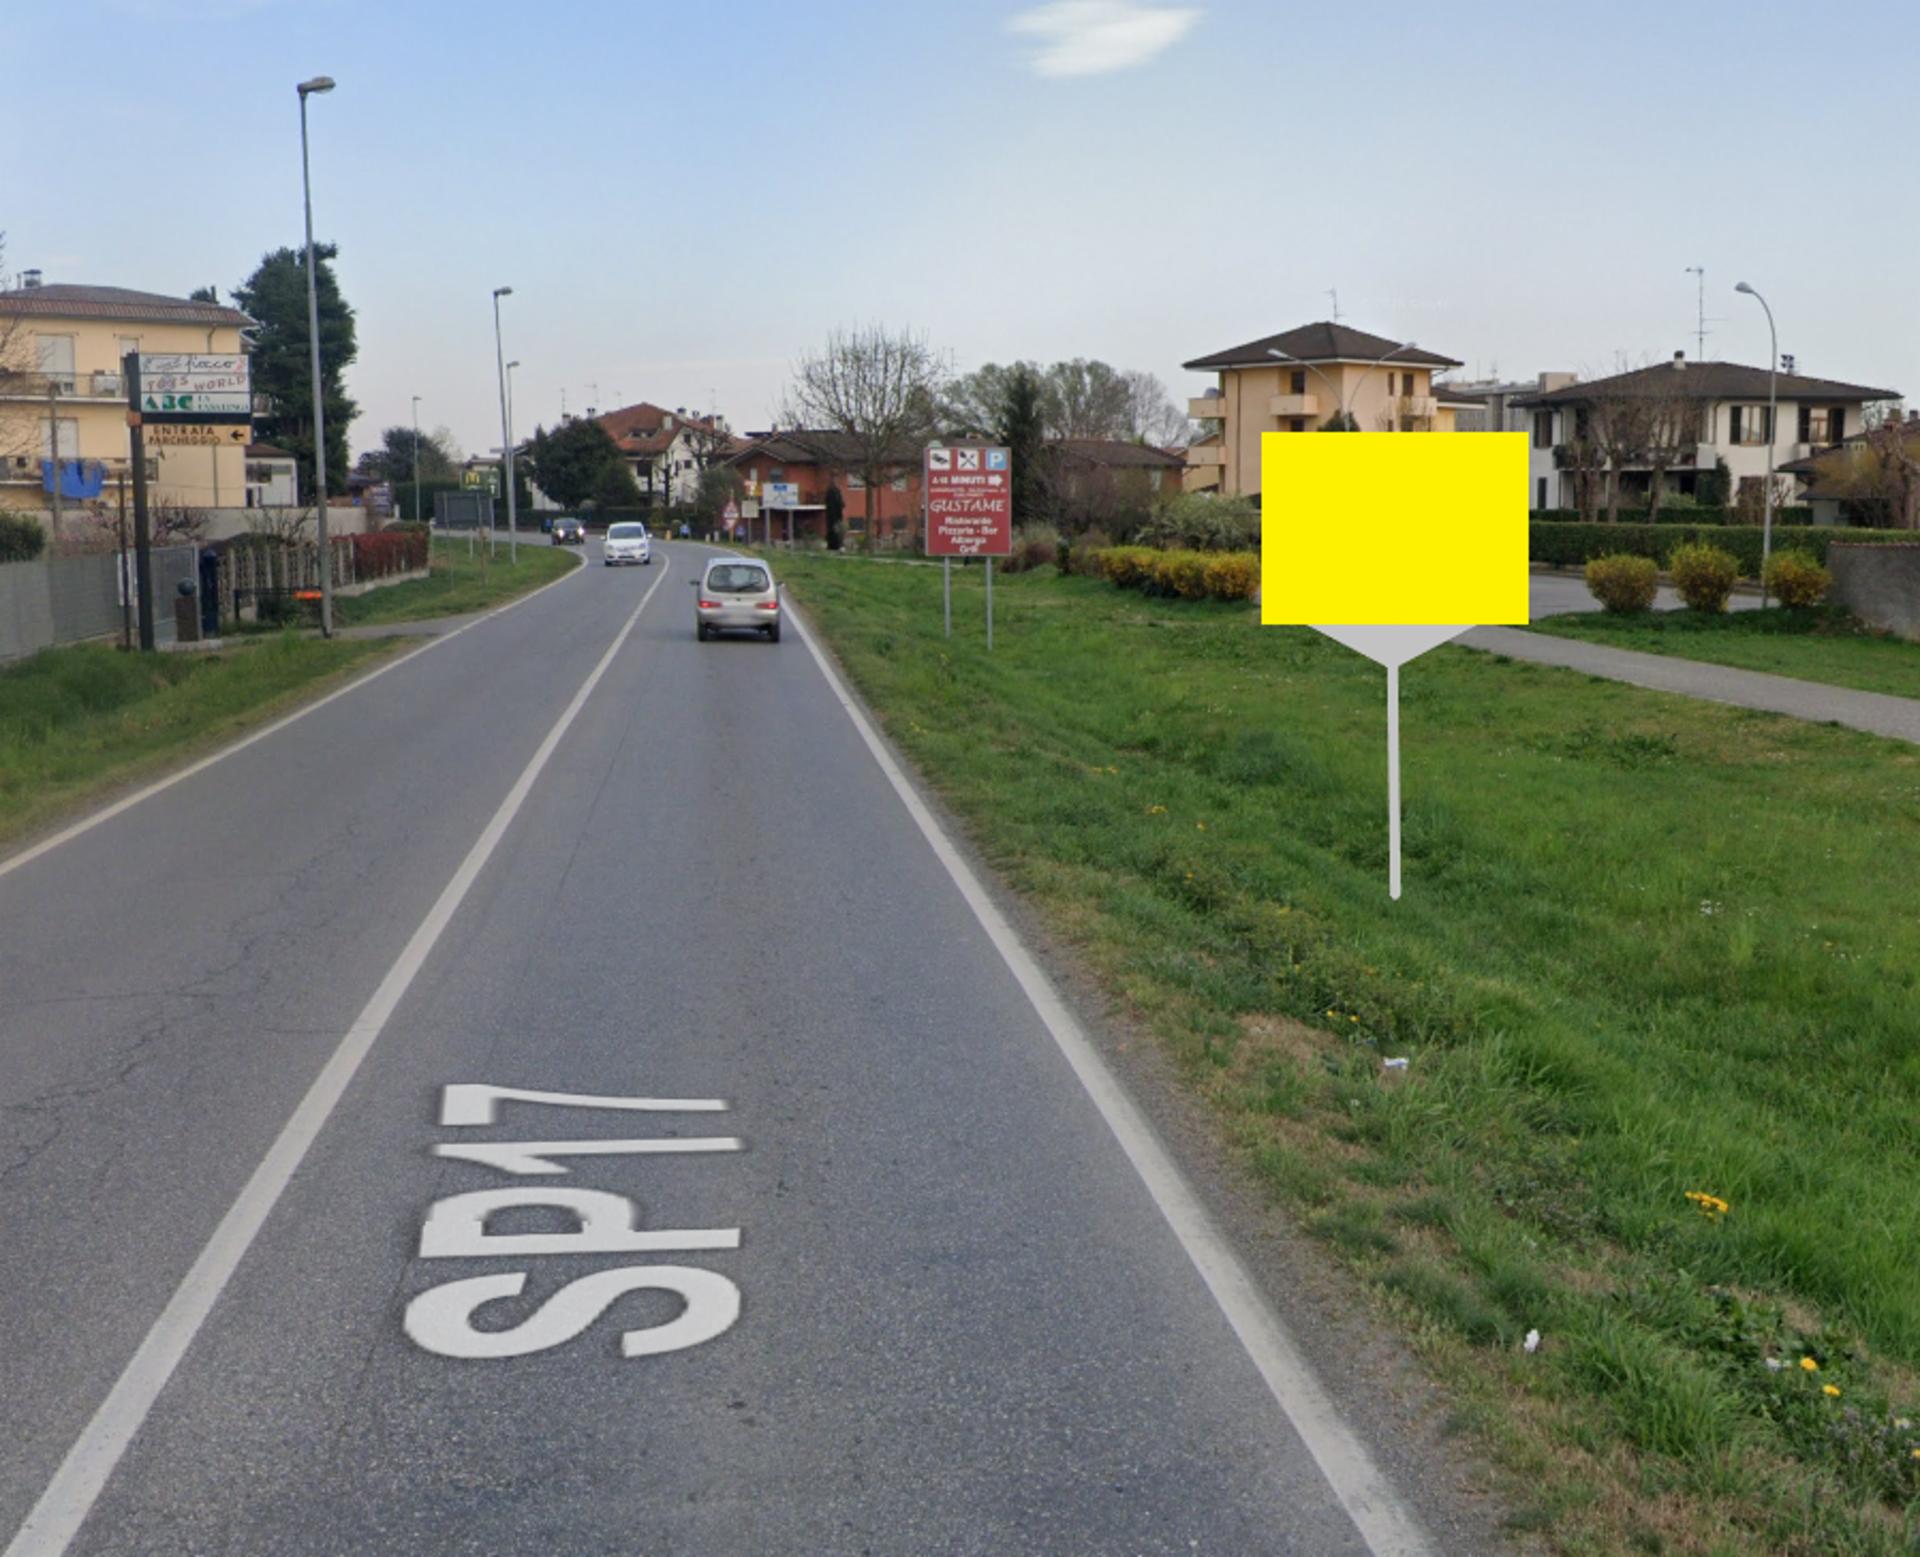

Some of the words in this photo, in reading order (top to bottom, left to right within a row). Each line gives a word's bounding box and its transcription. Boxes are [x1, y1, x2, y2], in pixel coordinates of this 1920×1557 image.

[193, 374, 246, 391] WORLD
[153, 426, 215, 435] ENTRATA
[149, 436, 221, 445] PARCHEGGIO
[930, 499, 1005, 513] GUSTAME
[944, 516, 993, 525] Ristorante
[938, 526, 974, 536] Pizzeria
[981, 526, 998, 535] Bar
[404, 1083, 741, 1359] SP17
